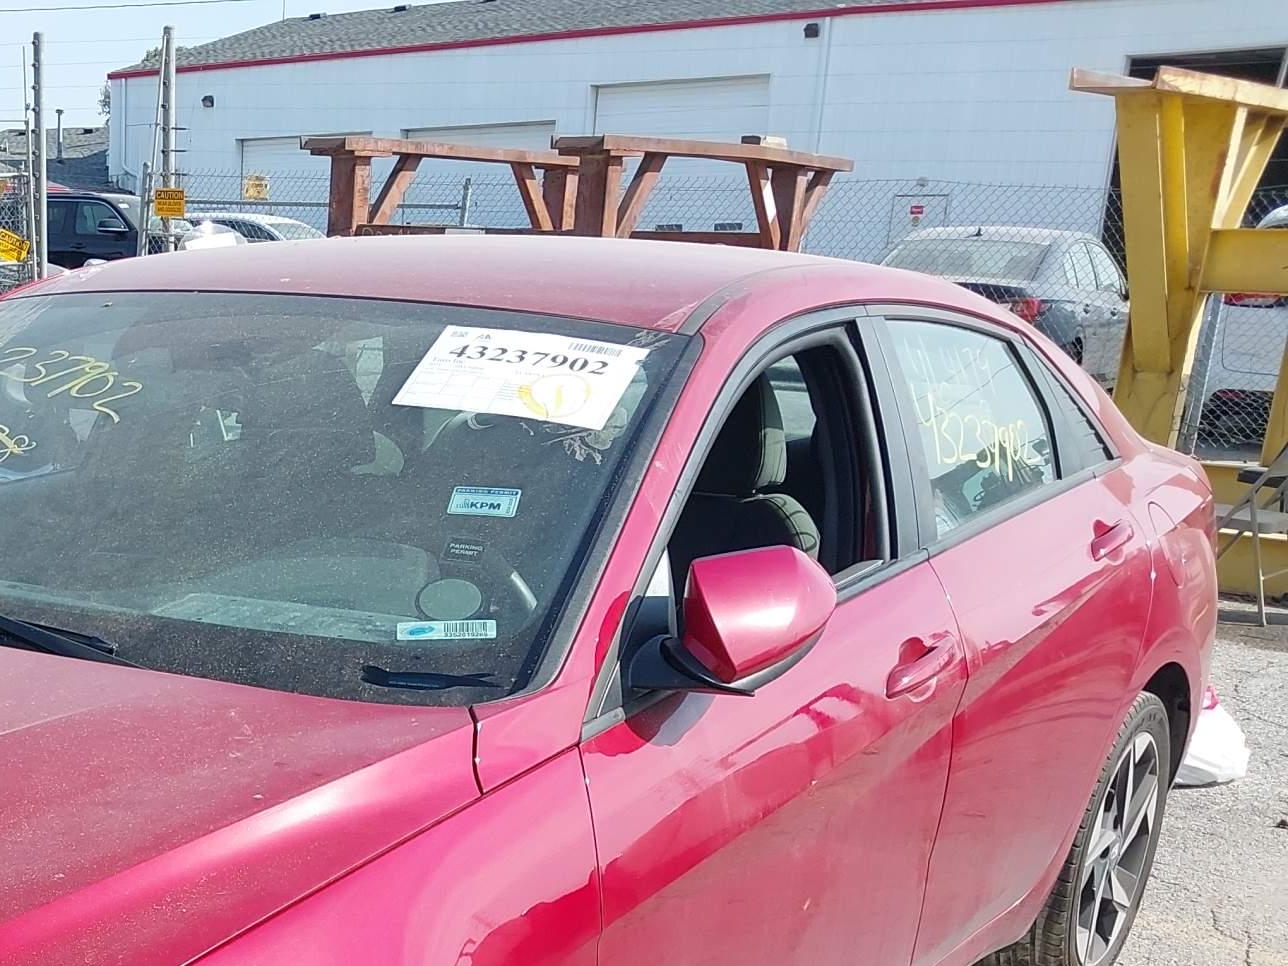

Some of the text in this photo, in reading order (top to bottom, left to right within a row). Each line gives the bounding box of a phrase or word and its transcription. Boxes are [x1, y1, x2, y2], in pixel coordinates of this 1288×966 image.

[156, 190, 183, 200] CAUTION
[0, 232, 28, 250] CAUTION
[449, 344, 609, 375] 43237902
[470, 501, 501, 510] KPM
[449, 543, 483, 552] PARKING
[450, 549, 478, 557] PERMIT
